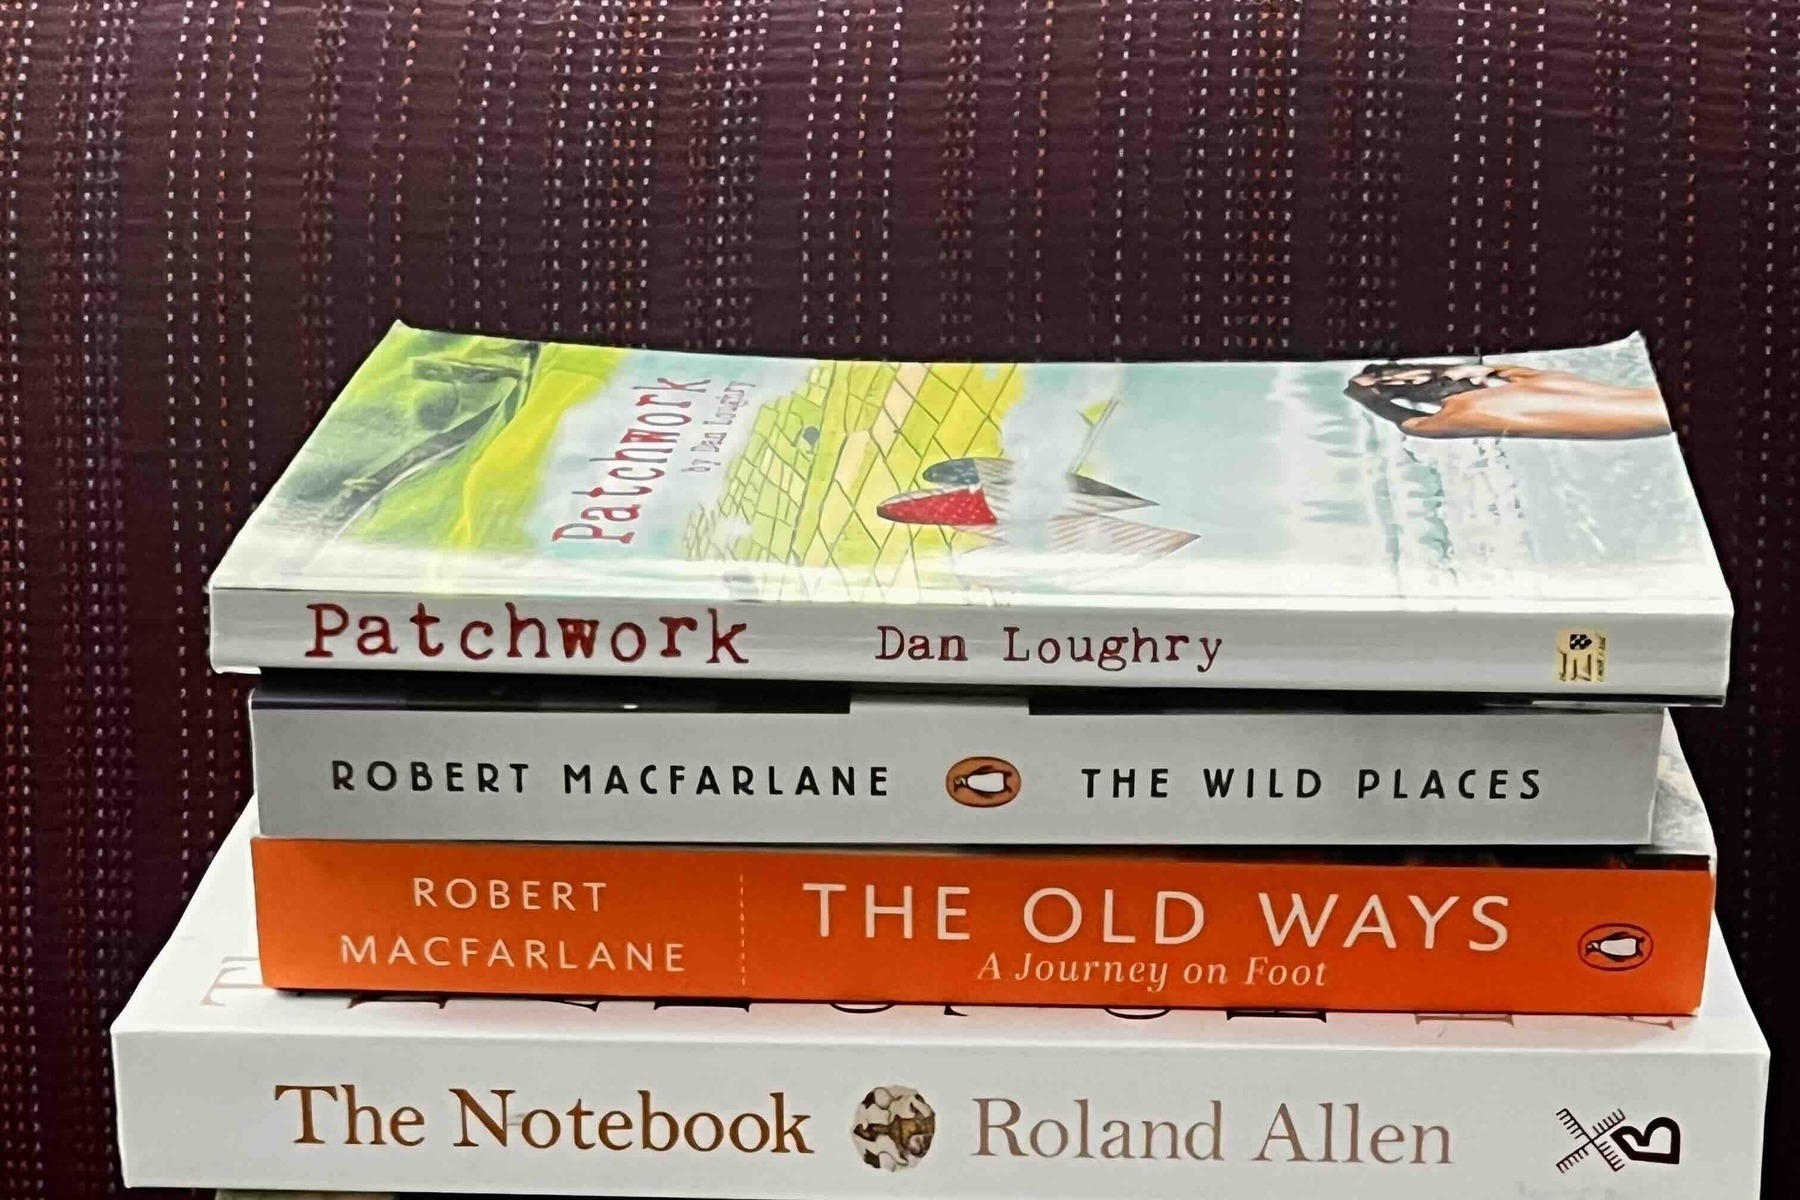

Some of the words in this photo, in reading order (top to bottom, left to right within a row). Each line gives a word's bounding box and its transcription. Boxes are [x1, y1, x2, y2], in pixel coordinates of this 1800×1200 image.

[552, 377, 711, 544] Patchwork
[680, 459, 721, 472] by
[305, 603, 748, 664] Patchwork
[877, 626, 968, 661] Dan
[1003, 627, 1222, 671] Loughry
[332, 761, 529, 794] ROBERT
[564, 765, 888, 796] MACFARLANE
[1082, 769, 1170, 798] THE
[1204, 769, 1321, 798] WILD
[1358, 769, 1541, 799] PLACES
[413, 878, 606, 911] ROBERT
[803, 882, 970, 941] THE
[1024, 888, 1202, 943] OLD
[1257, 893, 1510, 951] WAYS
[341, 935, 684, 972] MACFARLANE
[978, 953, 1001, 980] A
[1015, 953, 1167, 991] Journey
[1183, 958, 1226, 984] on
[1244, 957, 1327, 986] Foot
[275, 1085, 425, 1146] The
[449, 1089, 814, 1154] Notebook
[971, 1098, 1223, 1161] Roland
[1252, 1102, 1453, 1165] Allen
